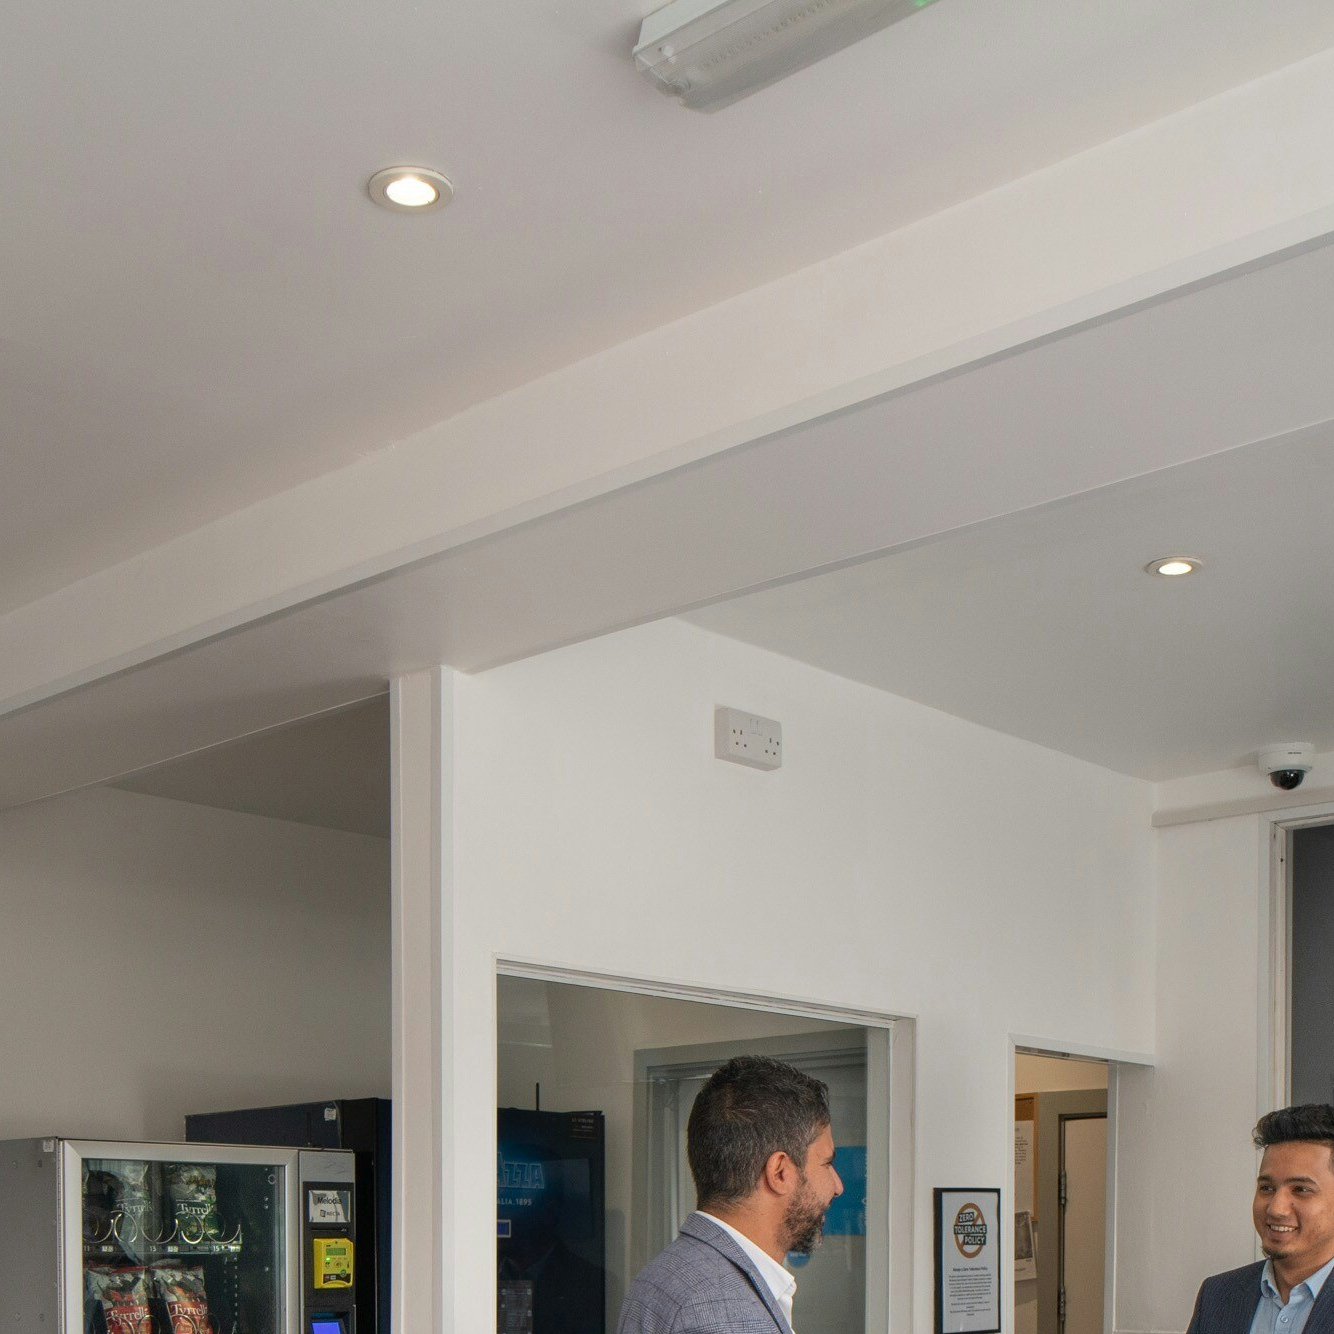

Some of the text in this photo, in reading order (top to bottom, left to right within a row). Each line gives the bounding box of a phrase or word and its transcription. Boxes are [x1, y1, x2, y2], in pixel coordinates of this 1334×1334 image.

[317, 1197, 342, 1205] Melodia
[958, 1213, 974, 1222] ZERO
[955, 1225, 986, 1234] TOLERANCE
[965, 1236, 985, 1244] POLICY
